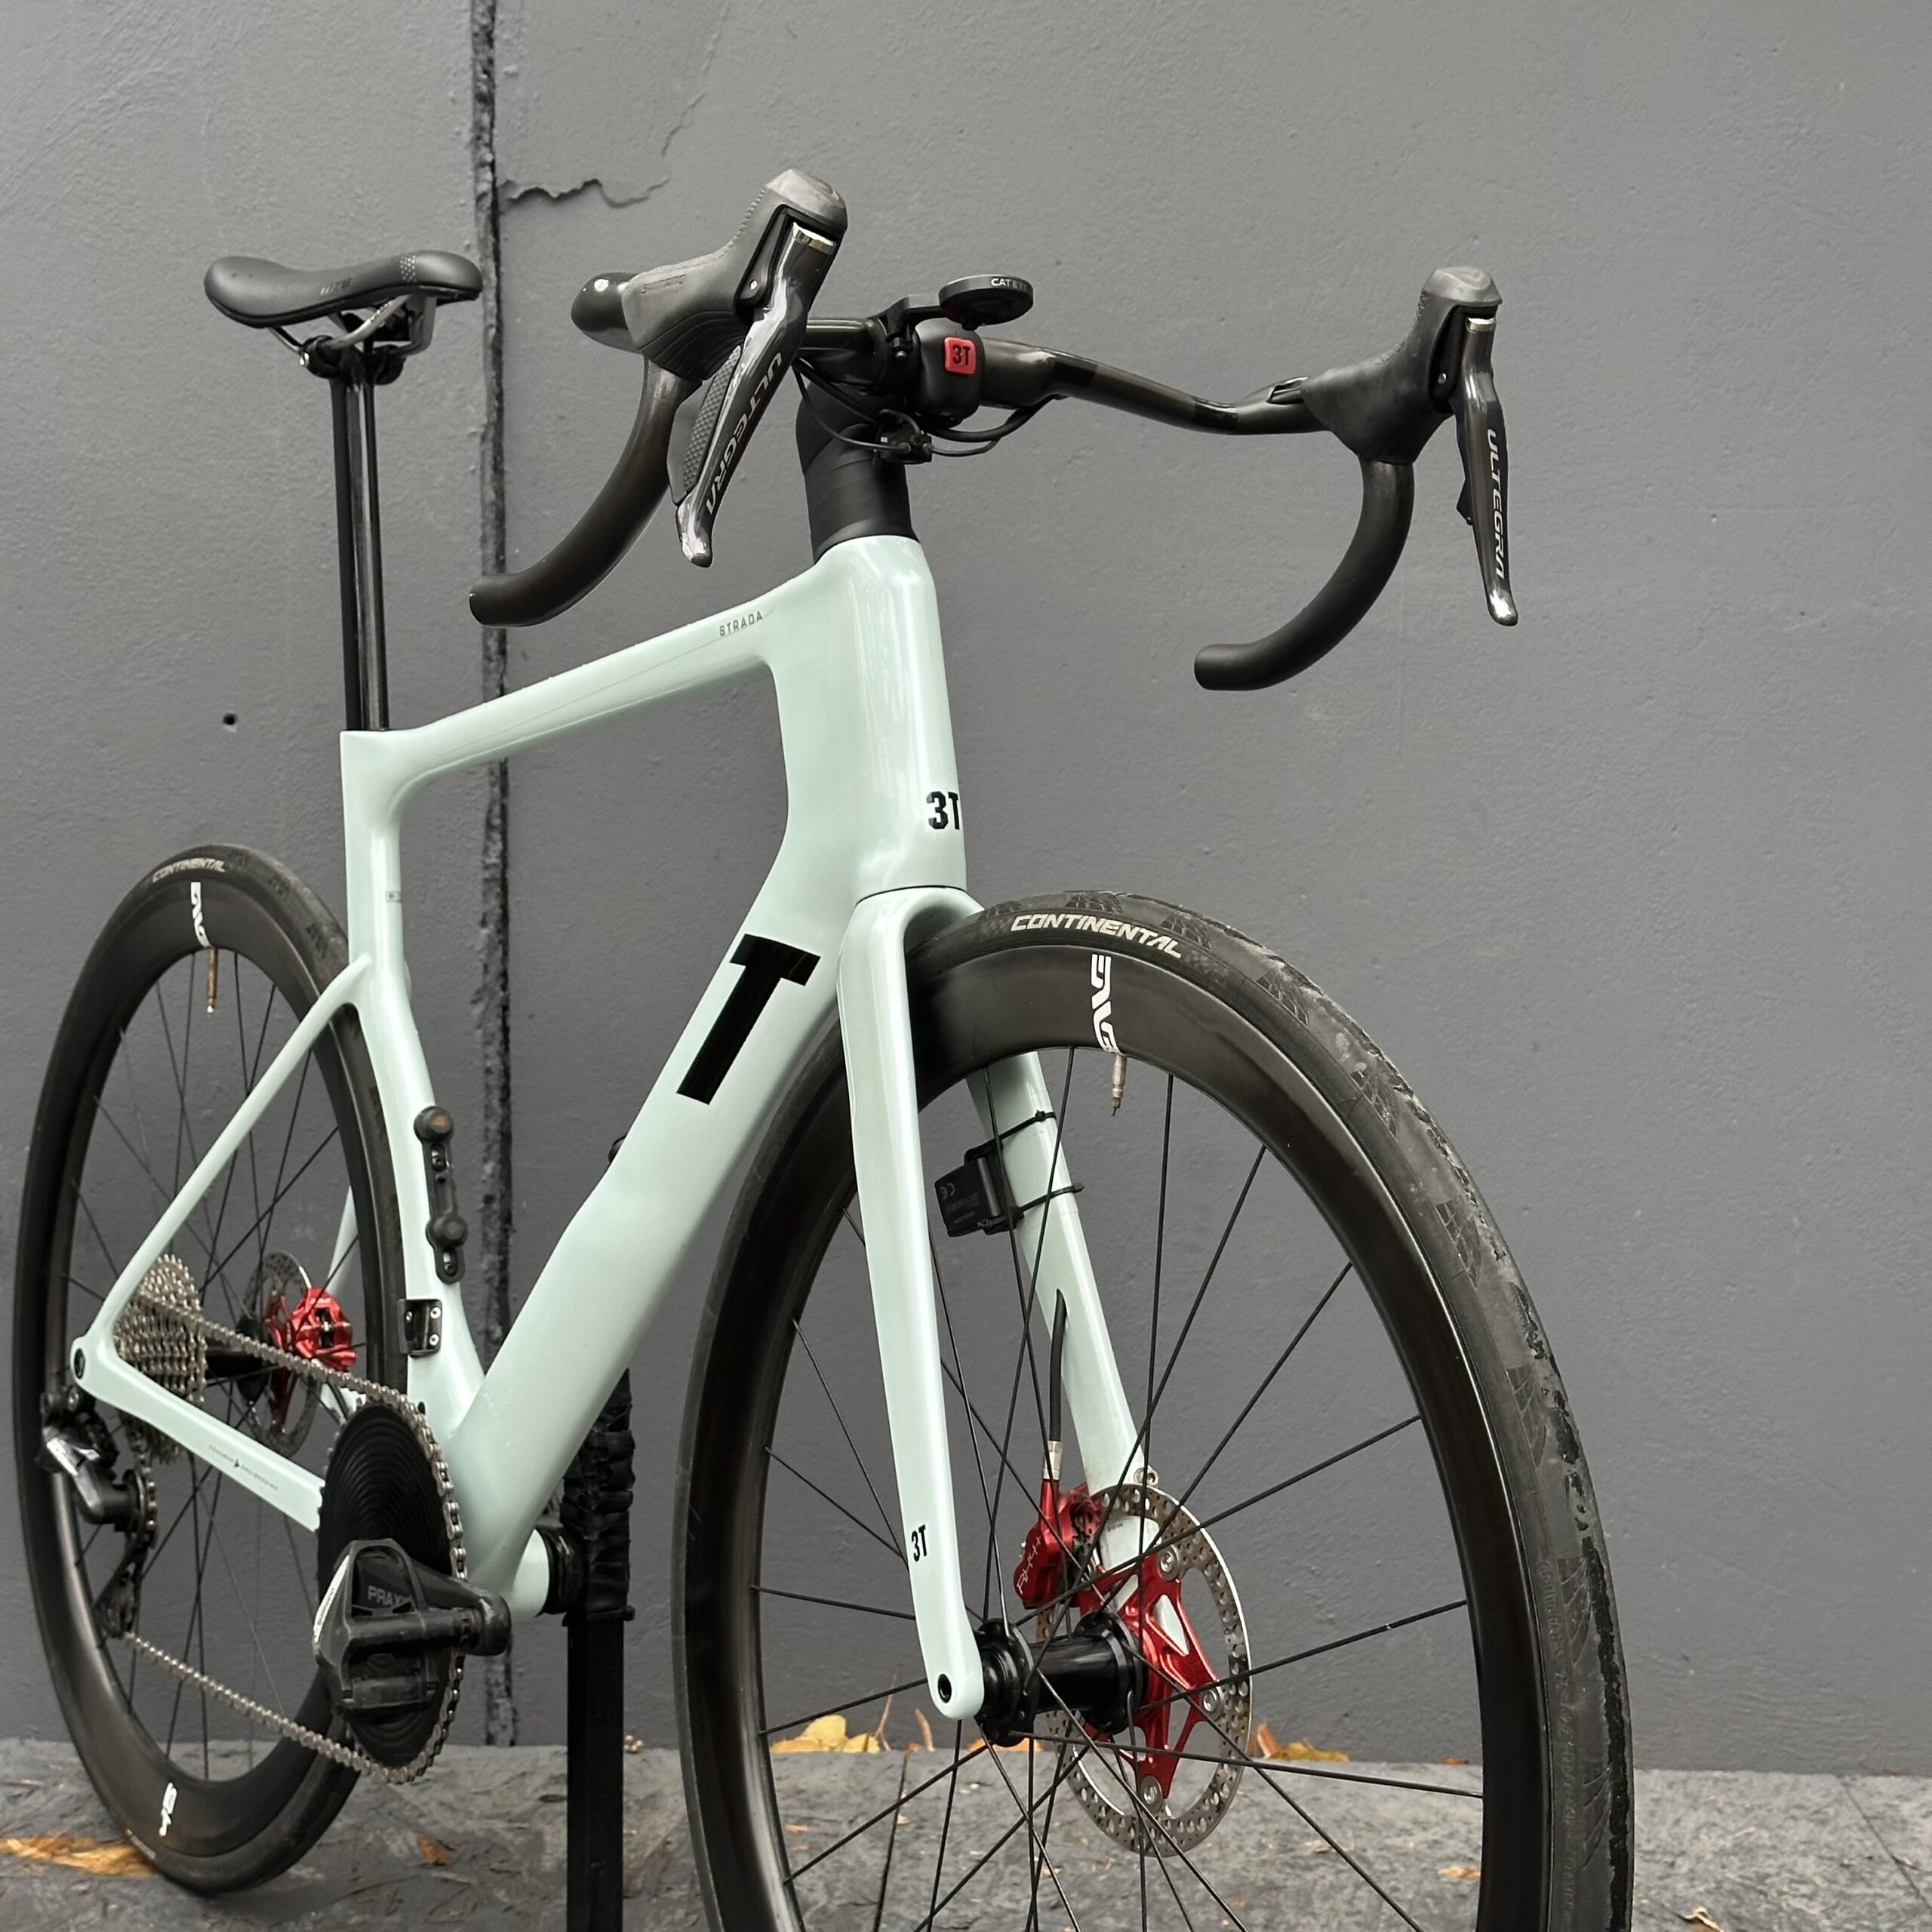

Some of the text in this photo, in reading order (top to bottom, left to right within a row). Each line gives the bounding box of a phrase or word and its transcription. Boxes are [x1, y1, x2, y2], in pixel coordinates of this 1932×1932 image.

[952, 345, 971, 366] 3T
[1487, 429, 1505, 580] ULTEGRA
[719, 611, 763, 636] STRADA
[926, 791, 960, 830] 3T
[152, 857, 226, 884] CONTINENTAL
[1011, 913, 1182, 958] CONTINENTAL
[911, 1524, 928, 1562] 3T
[368, 1585, 411, 1607] PRAX
